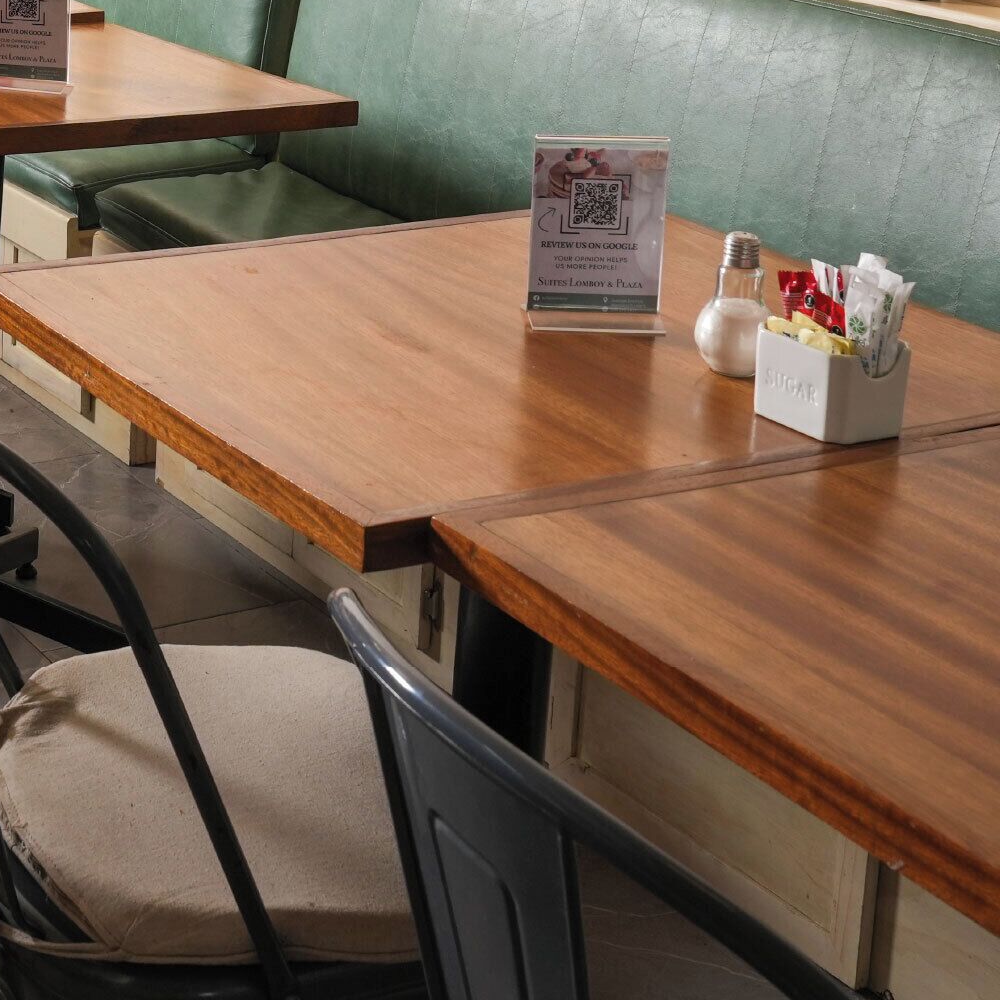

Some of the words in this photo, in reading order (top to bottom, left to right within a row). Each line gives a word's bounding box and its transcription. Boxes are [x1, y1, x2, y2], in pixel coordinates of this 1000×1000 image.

[541, 240, 575, 249] REVIEW
[575, 241, 587, 249] US
[588, 242, 601, 250] ON
[602, 242, 639, 251] GOOGLE
[607, 280, 613, 288] &
[764, 367, 818, 406] SUGAR
